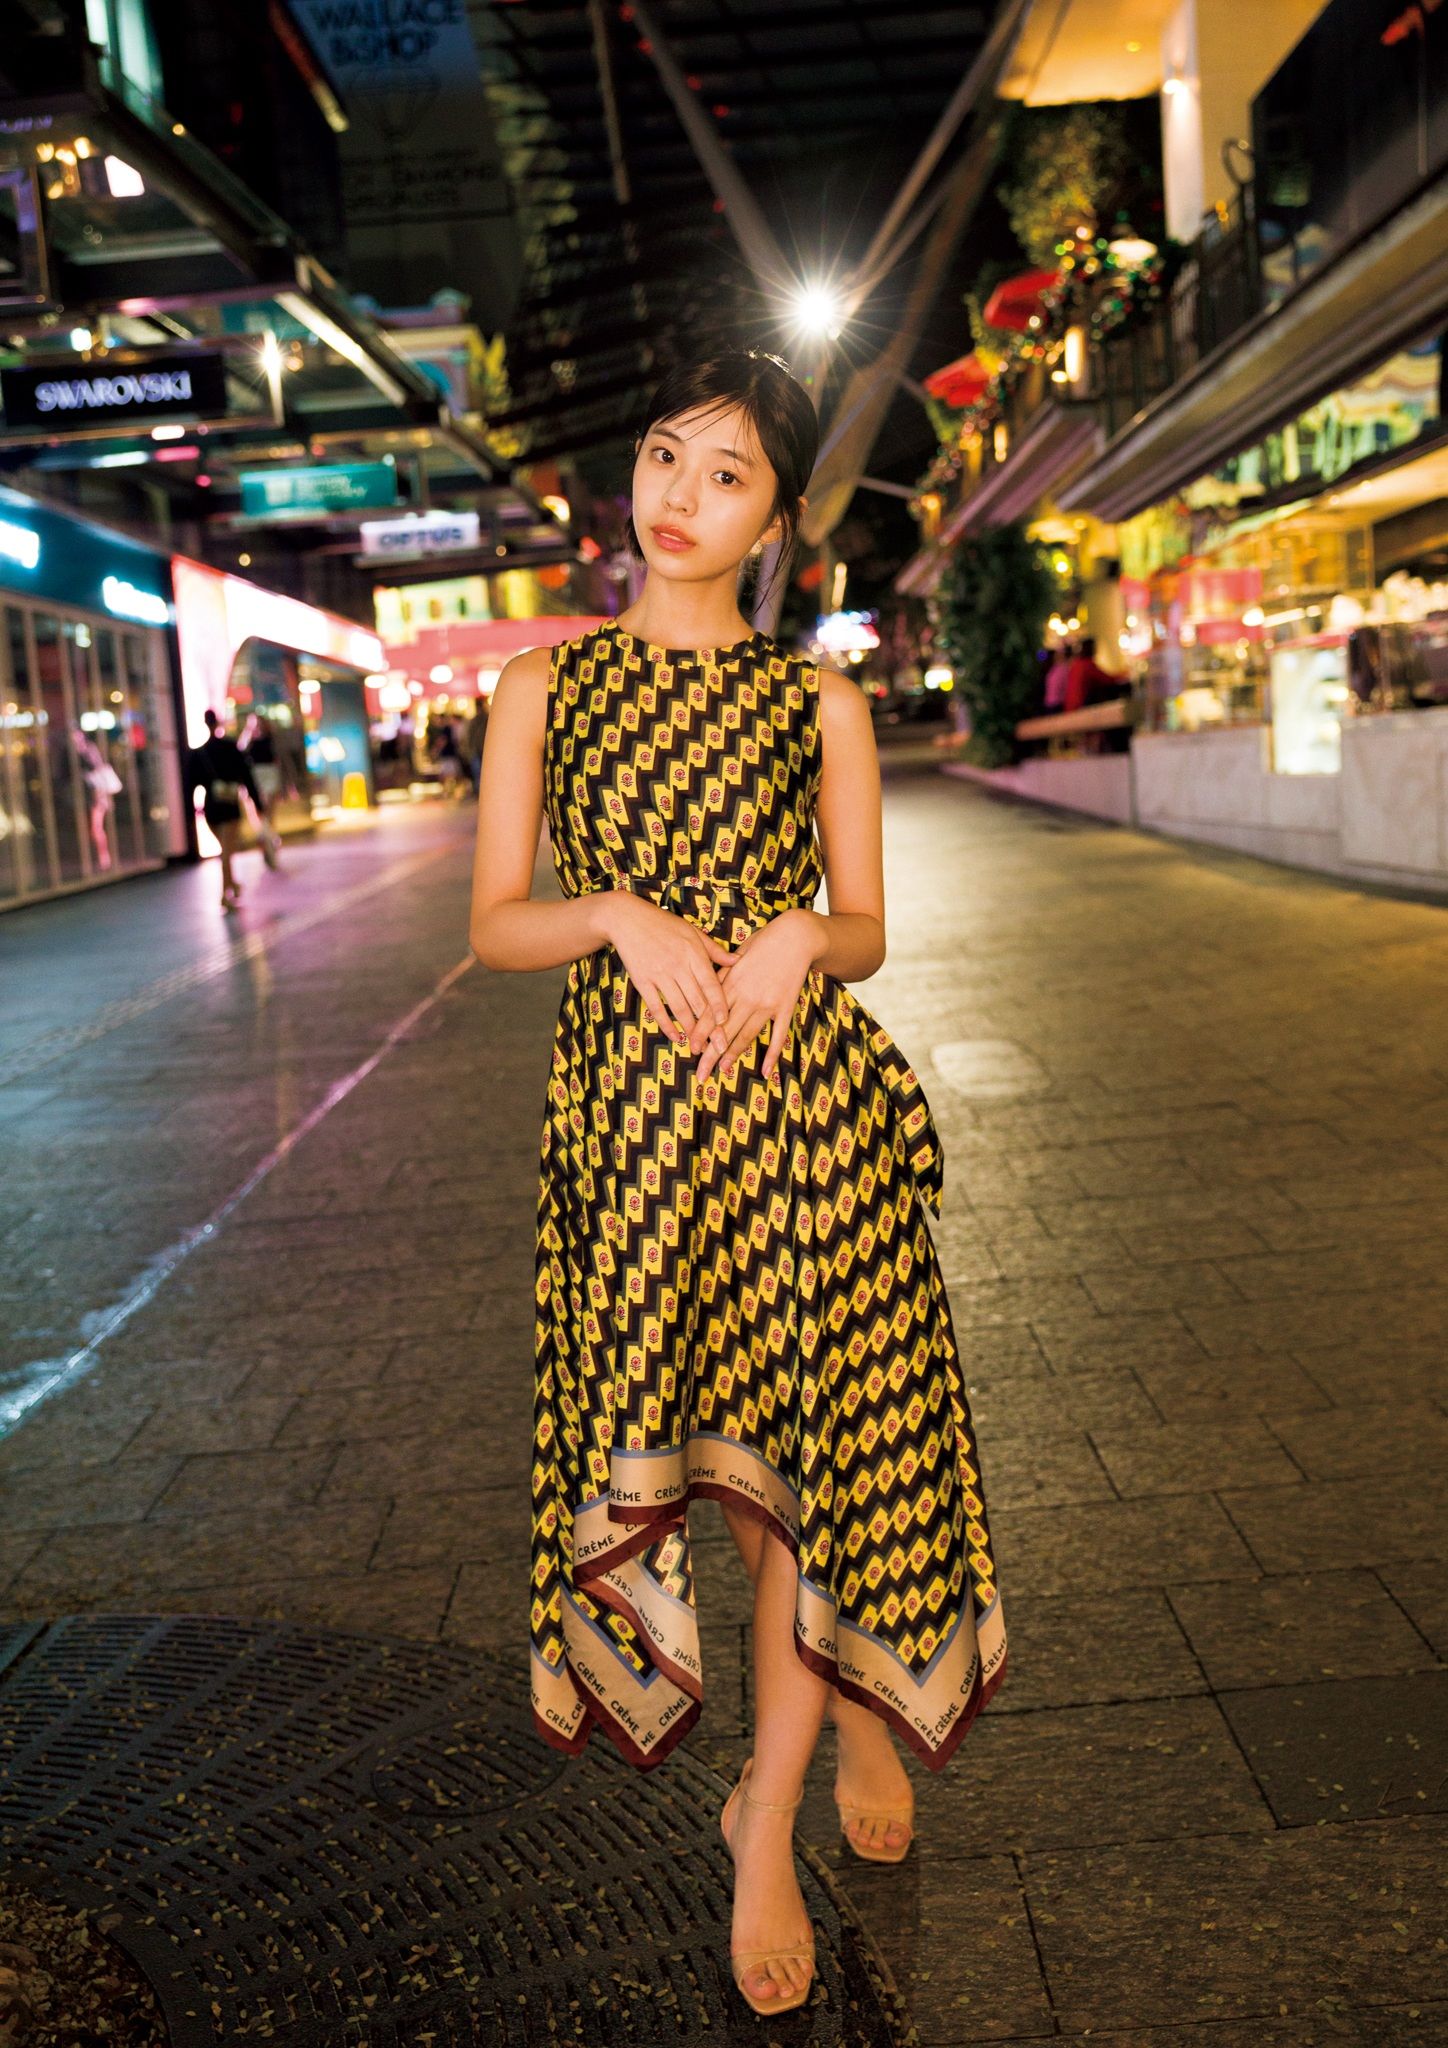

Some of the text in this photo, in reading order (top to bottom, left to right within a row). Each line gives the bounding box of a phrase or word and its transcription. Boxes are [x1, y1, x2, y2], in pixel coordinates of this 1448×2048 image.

[35, 370, 192, 412] SWAROVSKI
[379, 527, 464, 548] OPTUS
[608, 1488, 641, 1502] RÈME
[729, 1475, 766, 1502] CRÈME
[577, 1534, 616, 1558] CRÈME
[577, 1661, 640, 1735] CRÈME CRÈME
[840, 1661, 867, 1681] CRÈME
[874, 1681, 909, 1713] CRÈME
[658, 1697, 688, 1728] CRÈME
[935, 1702, 960, 1735] CRÈME
